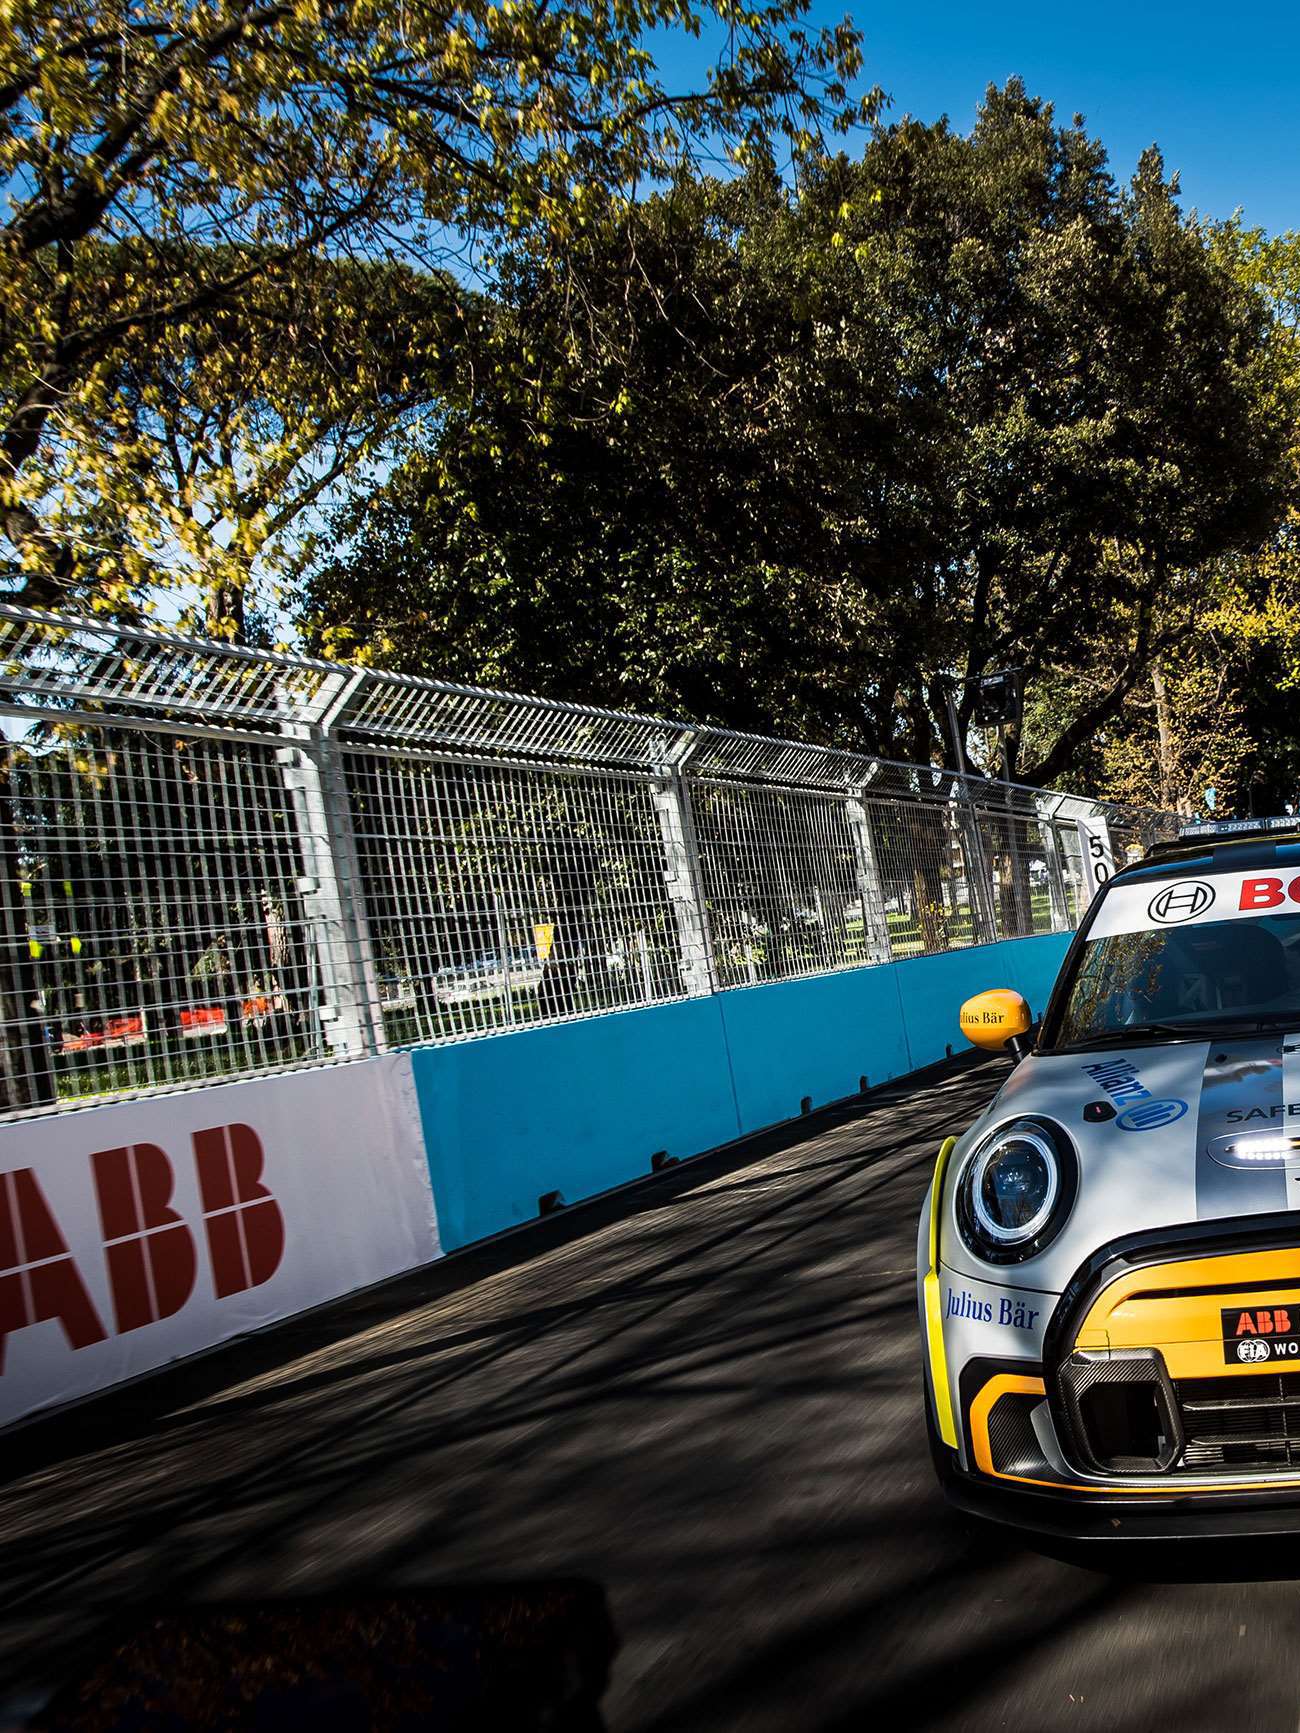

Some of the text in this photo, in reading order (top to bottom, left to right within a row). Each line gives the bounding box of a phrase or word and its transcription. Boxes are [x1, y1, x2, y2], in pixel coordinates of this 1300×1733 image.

[983, 1011, 1005, 1024] Bär
[1080, 1058, 1152, 1107] Allianz
[0, 1122, 286, 1377] ABB
[946, 1288, 1040, 1330] Julius Bär
[1236, 1309, 1291, 1336] ABB
